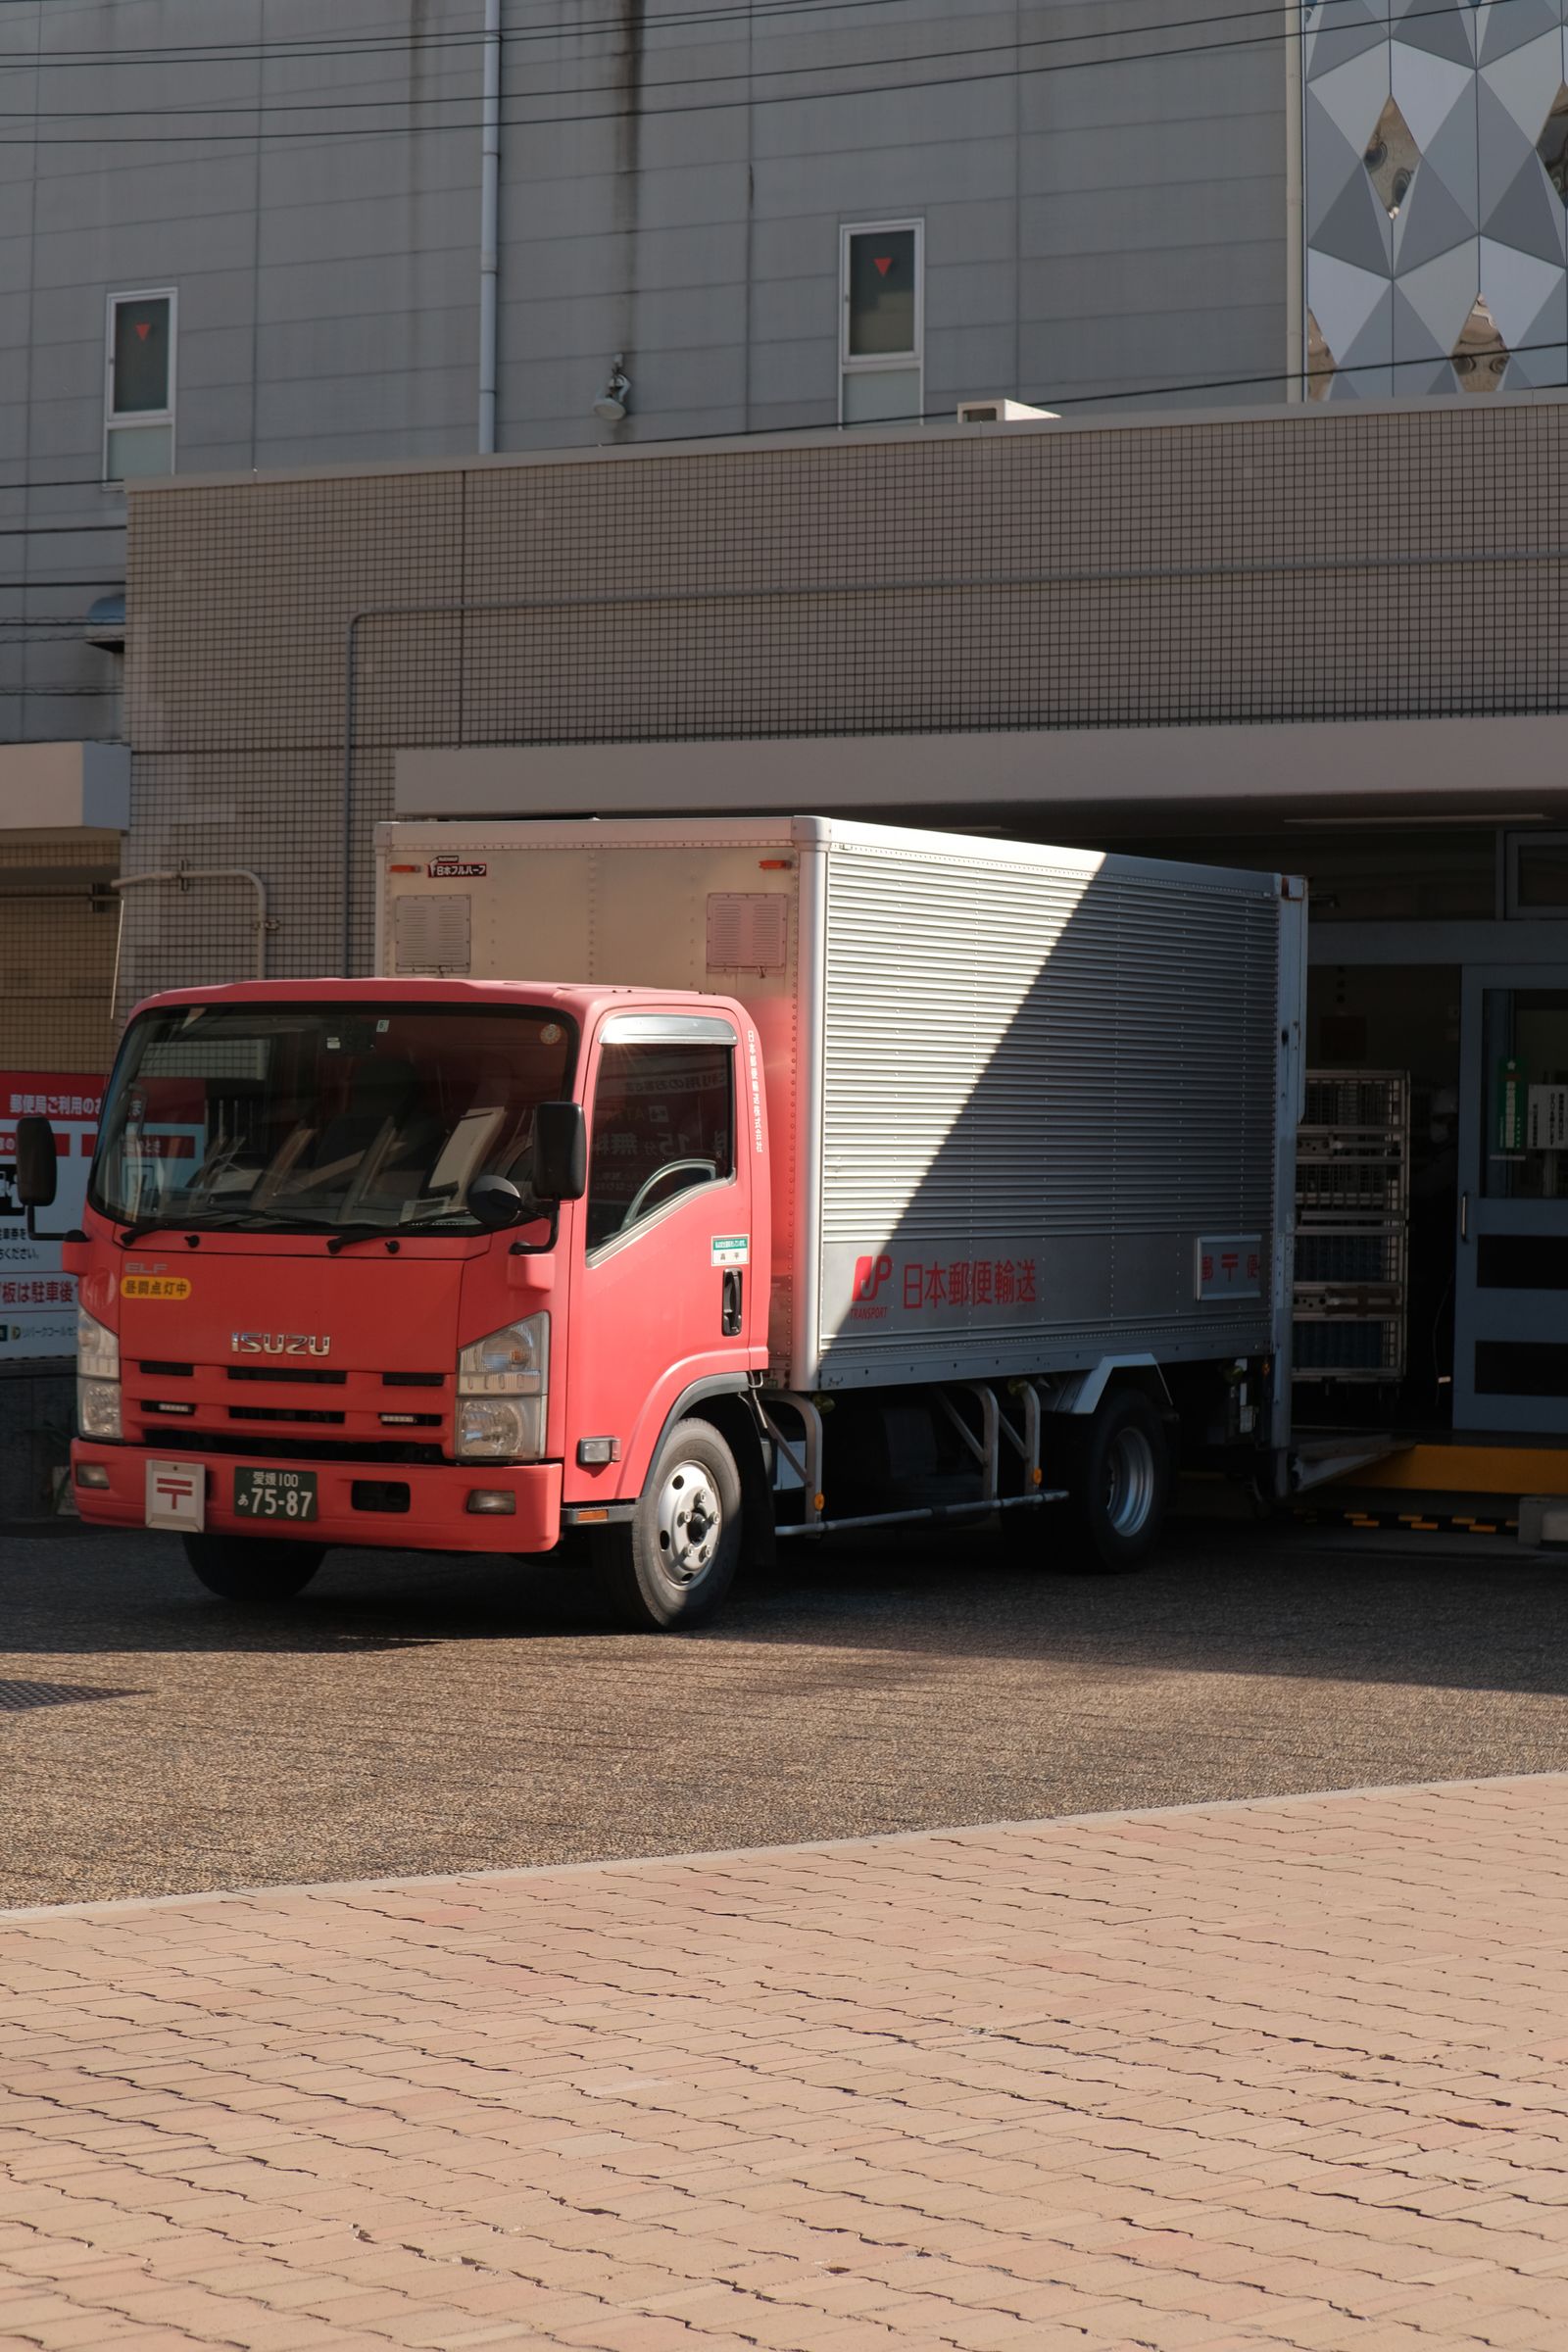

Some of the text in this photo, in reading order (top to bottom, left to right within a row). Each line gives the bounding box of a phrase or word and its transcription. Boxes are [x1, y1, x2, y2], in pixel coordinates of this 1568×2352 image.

[437, 864, 486, 876] 日本フルハーフ
[125, 1262, 169, 1273] ELF
[125, 1280, 187, 1297] 昼間点灯中
[903, 1259, 1036, 1310] 日本郵便輸送
[850, 1305, 888, 1321] TRANSPORT
[231, 1332, 331, 1356] ISUZU
[253, 1471, 298, 1488] 愛媛 100
[237, 1488, 314, 1518] あ 75-87
